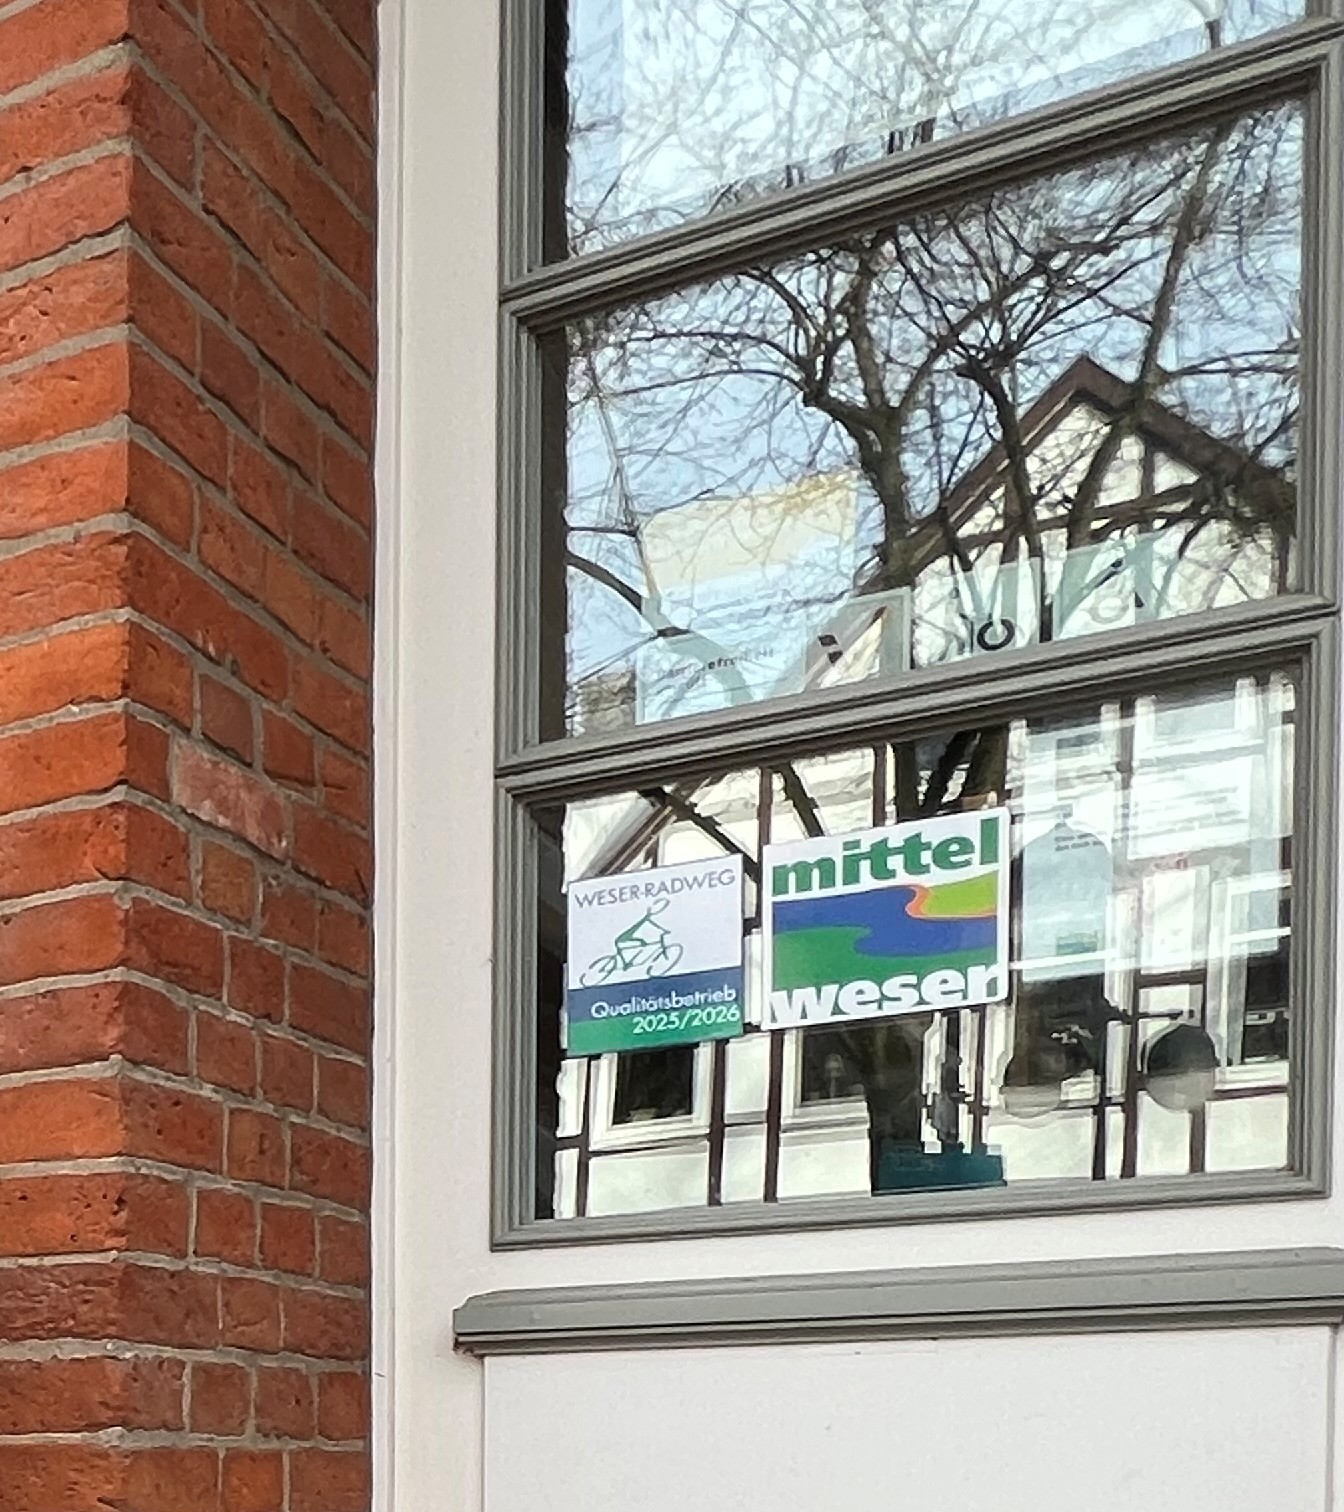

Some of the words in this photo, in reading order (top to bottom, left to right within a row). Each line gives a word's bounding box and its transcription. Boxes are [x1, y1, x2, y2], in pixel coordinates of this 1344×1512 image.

[772, 817, 1000, 897] mittel
[574, 868, 736, 908] WESER-RADWEG
[590, 984, 737, 1019] Qualitätsbetrieb
[768, 963, 1004, 1024] weser
[632, 1004, 741, 1035] 2025/2026
